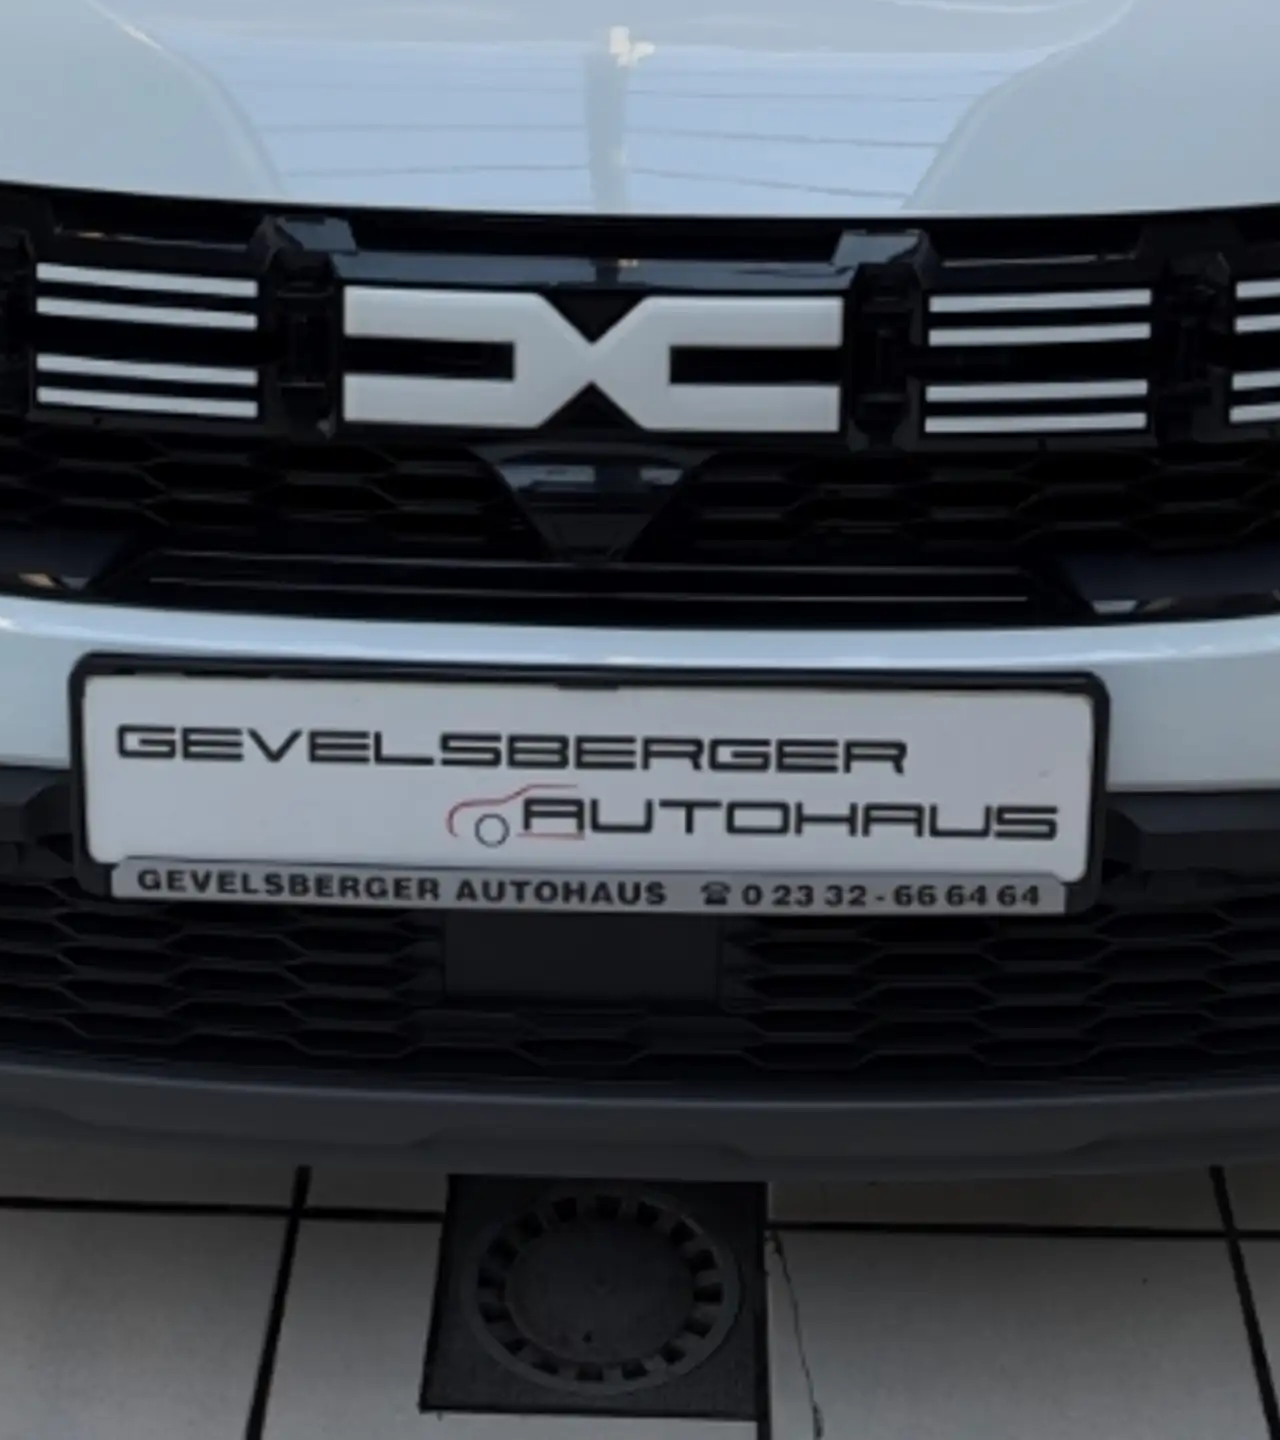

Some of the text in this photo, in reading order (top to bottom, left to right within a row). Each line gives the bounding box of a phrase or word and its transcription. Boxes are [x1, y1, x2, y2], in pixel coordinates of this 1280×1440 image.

[117, 723, 908, 775] GEVELSBERGER
[522, 797, 1058, 841] AUTOHAUS
[136, 868, 441, 902] GEVELSBERGER
[455, 878, 668, 906] AUTOHAUS
